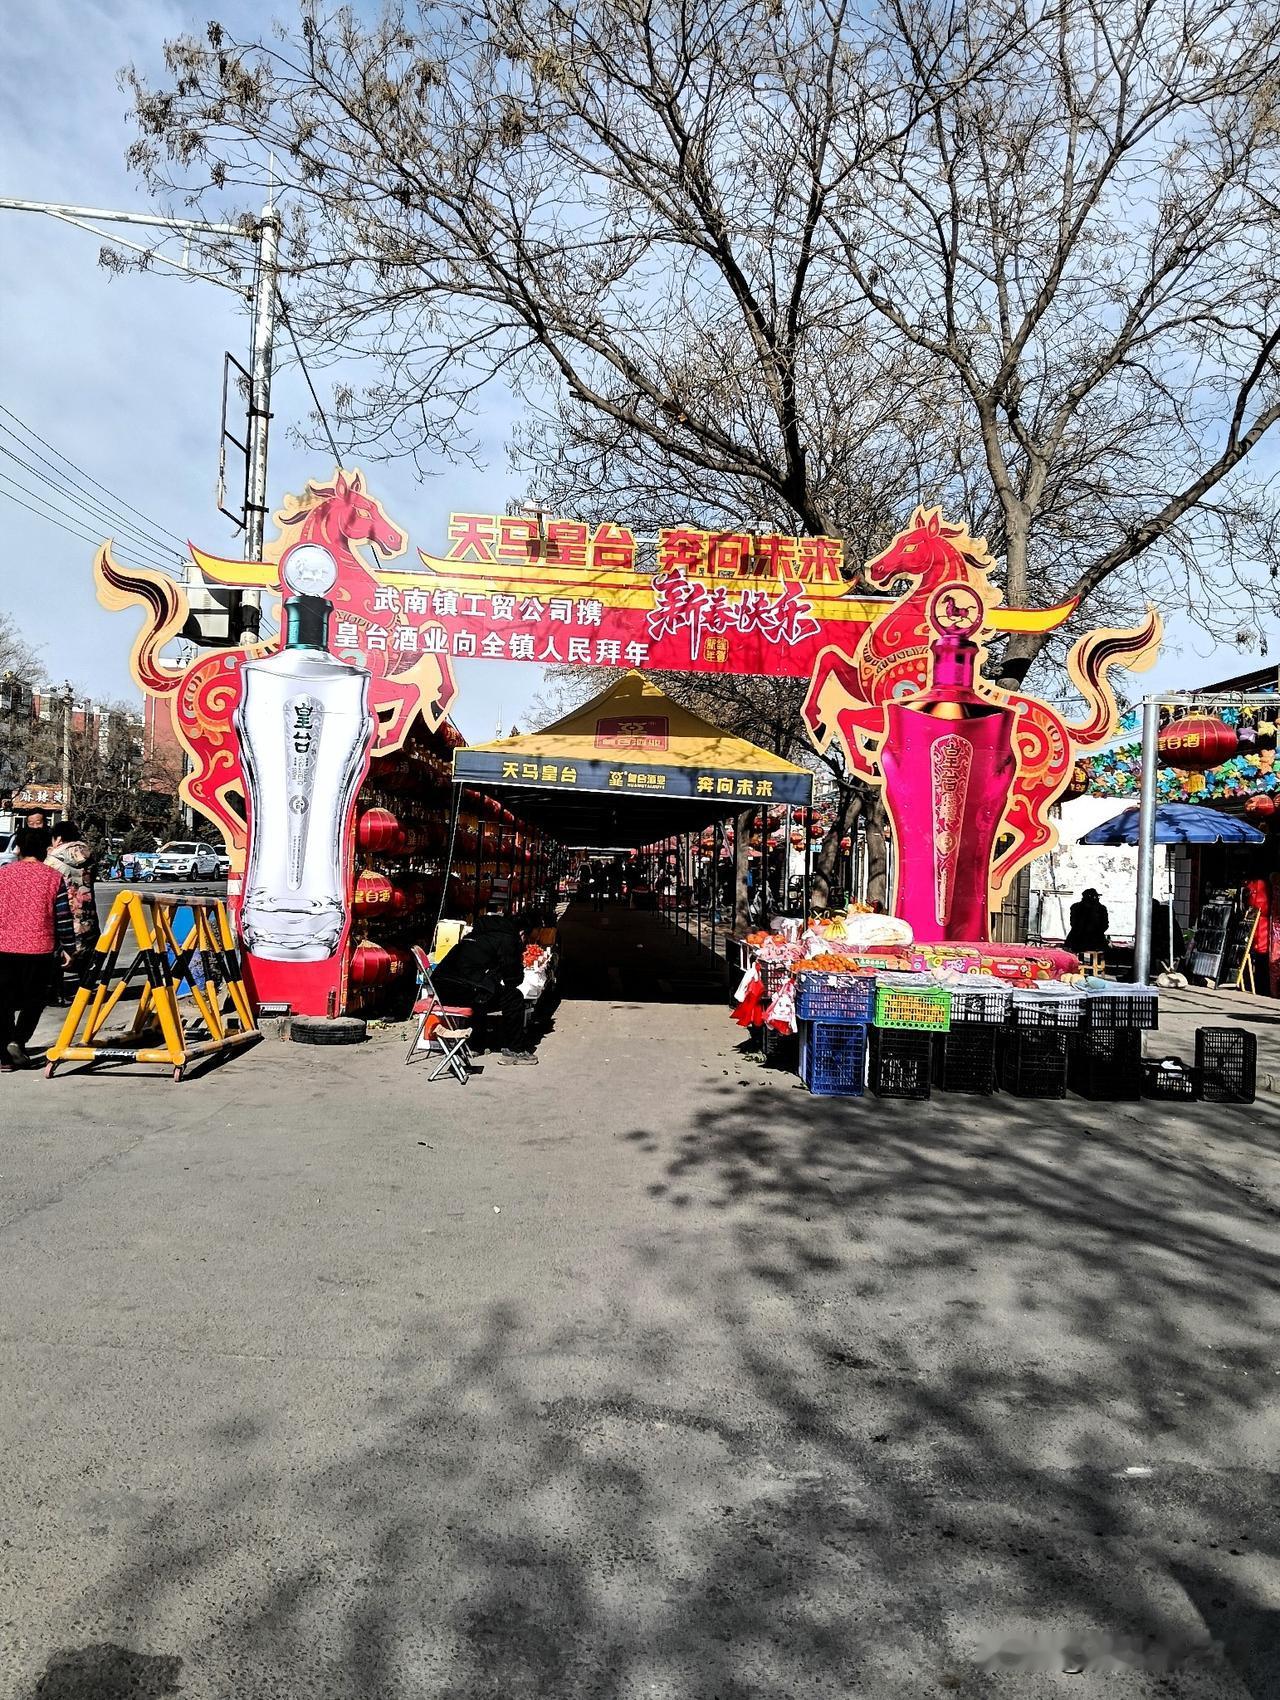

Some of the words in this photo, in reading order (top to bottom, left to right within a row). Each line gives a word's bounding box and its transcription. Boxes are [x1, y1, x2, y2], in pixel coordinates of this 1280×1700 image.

[448, 512, 635, 571] 天马皇台
[658, 529, 844, 583] 奔向未来
[373, 586, 603, 626] 武南镇工贸公司携
[647, 568, 821, 660] 新春快乐
[333, 622, 650, 667] 皇台酒业向全镇人民拜年
[294, 703, 314, 754] 皇台
[502, 762, 577, 783] 天马皇台
[697, 776, 774, 797] 奔向未来
